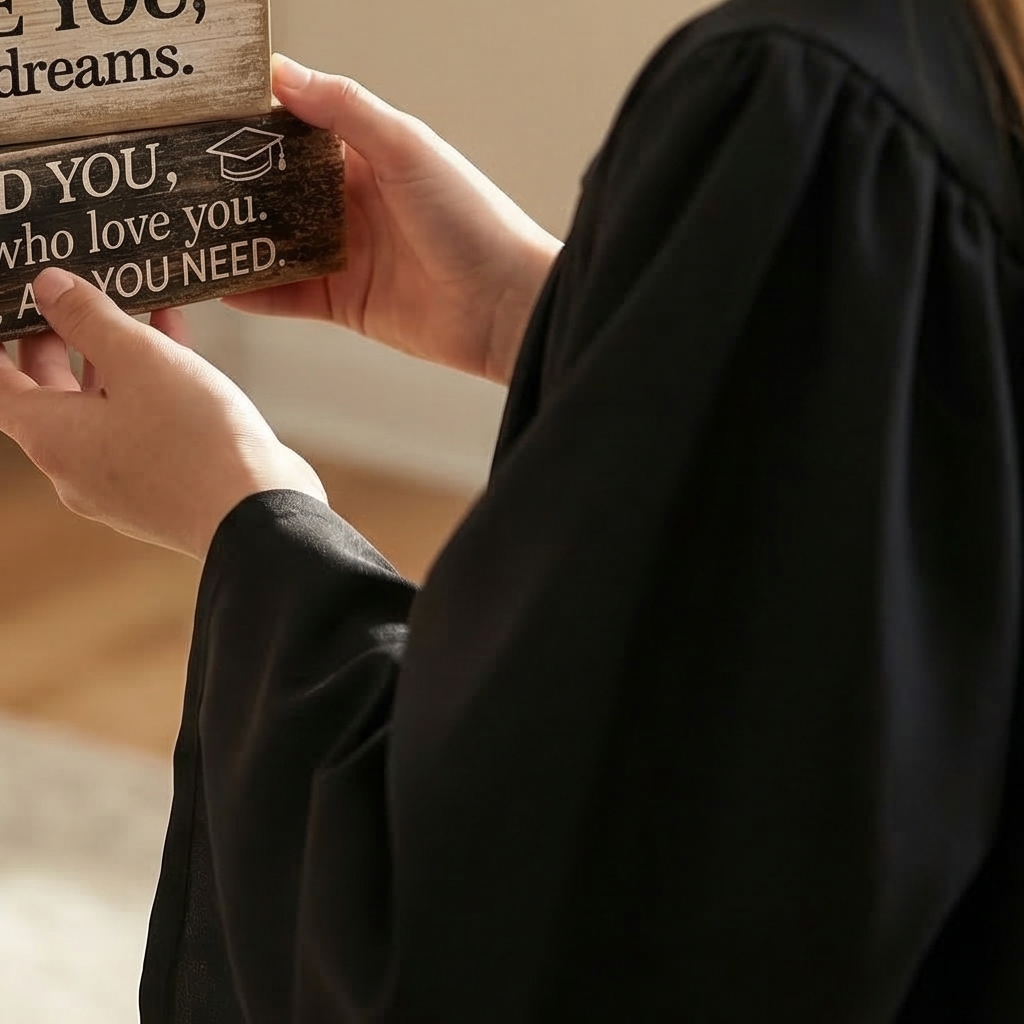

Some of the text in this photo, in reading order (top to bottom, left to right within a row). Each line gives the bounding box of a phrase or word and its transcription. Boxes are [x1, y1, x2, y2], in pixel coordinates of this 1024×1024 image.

[46, 142, 177, 204] YOU,
[88, 208, 170, 254] love
[182, 194, 267, 247] you.
[90, 258, 170, 299] YOU
[182, 237, 286, 286] NEED.
